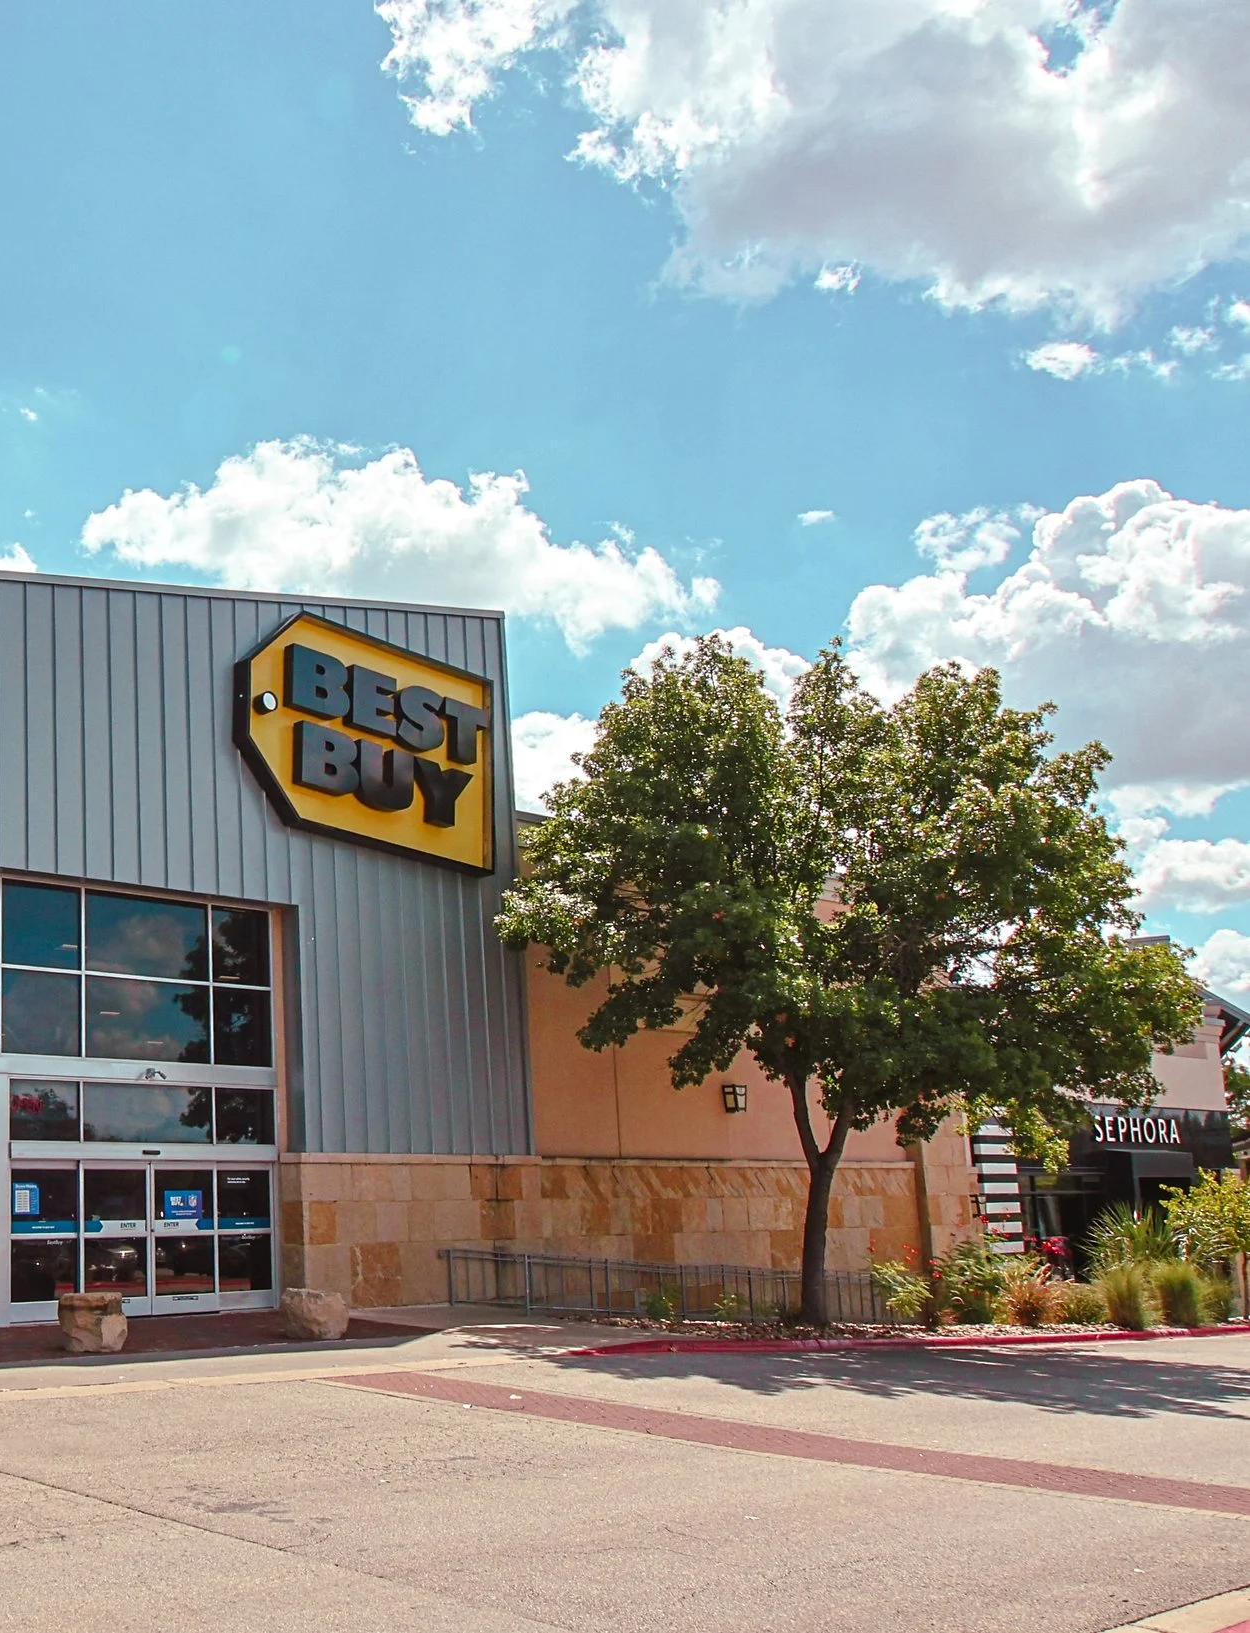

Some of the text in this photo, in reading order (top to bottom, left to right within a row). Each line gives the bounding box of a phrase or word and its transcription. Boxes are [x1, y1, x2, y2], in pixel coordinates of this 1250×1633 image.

[284, 643, 489, 765] BEST
[292, 720, 473, 827] BUY
[1094, 1115, 1181, 1144] SEPHORA
